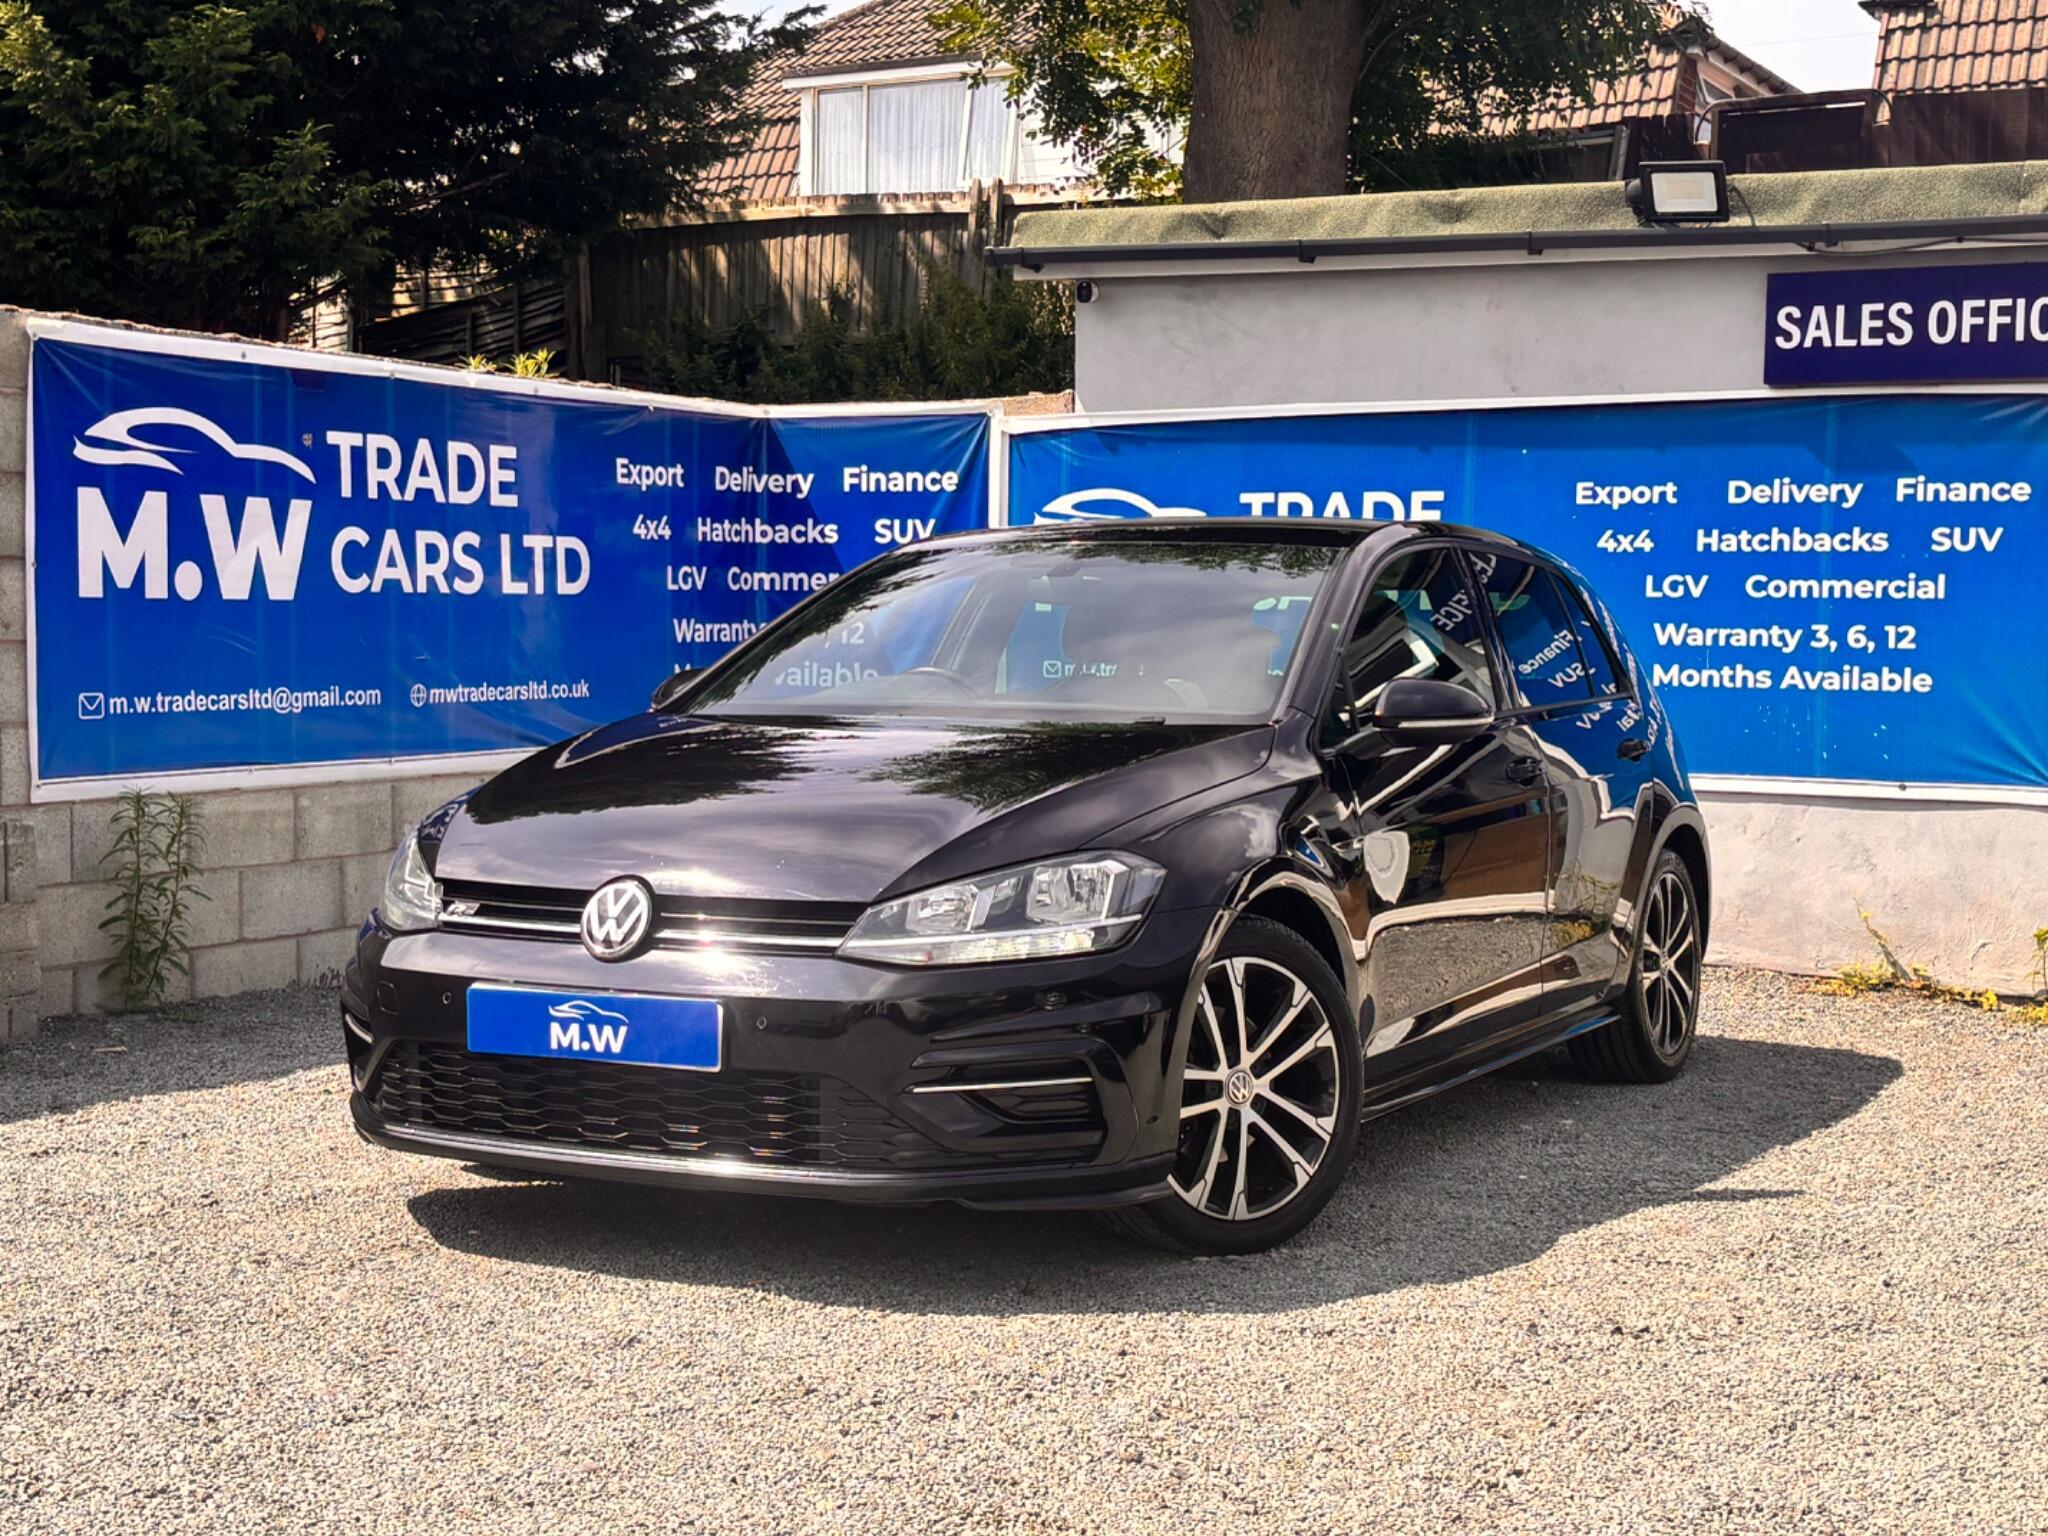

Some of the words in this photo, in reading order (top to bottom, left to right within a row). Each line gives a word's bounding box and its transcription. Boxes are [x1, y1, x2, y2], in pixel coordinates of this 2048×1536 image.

[1775, 301, 1914, 350] SALES
[326, 430, 519, 508] TRADE
[616, 457, 685, 491] Export
[715, 466, 815, 499] Delivery
[843, 464, 959, 493] Finance
[1575, 481, 1678, 510] Export
[1727, 477, 1864, 509] Delivery
[1896, 474, 2032, 502] Finance
[77, 486, 316, 601] M.W
[632, 514, 672, 540] 4x4
[697, 517, 839, 544] Hatchbacks
[874, 518, 936, 544] SUV
[1596, 529, 1655, 553] 4x4
[1696, 526, 1889, 553] Hatchbacks
[1931, 526, 2004, 552] SUV
[330, 526, 484, 595] CARS
[500, 533, 590, 595] LTD
[666, 565, 707, 591] LGV
[1645, 574, 1709, 598] LGV
[1745, 572, 1946, 600] Commercial
[1653, 623, 1803, 653] Warranty
[1810, 624, 1838, 653] 3,
[1846, 624, 1876, 653] 6,
[1884, 625, 1917, 650] 12
[429, 679, 590, 704] mwtradecarsltd.co.uk
[1652, 663, 1772, 689] Months
[1779, 664, 1933, 693] Available
[109, 685, 381, 714] m.w.tradecarsltd@gmail.com
[549, 1021, 628, 1054] M.W
